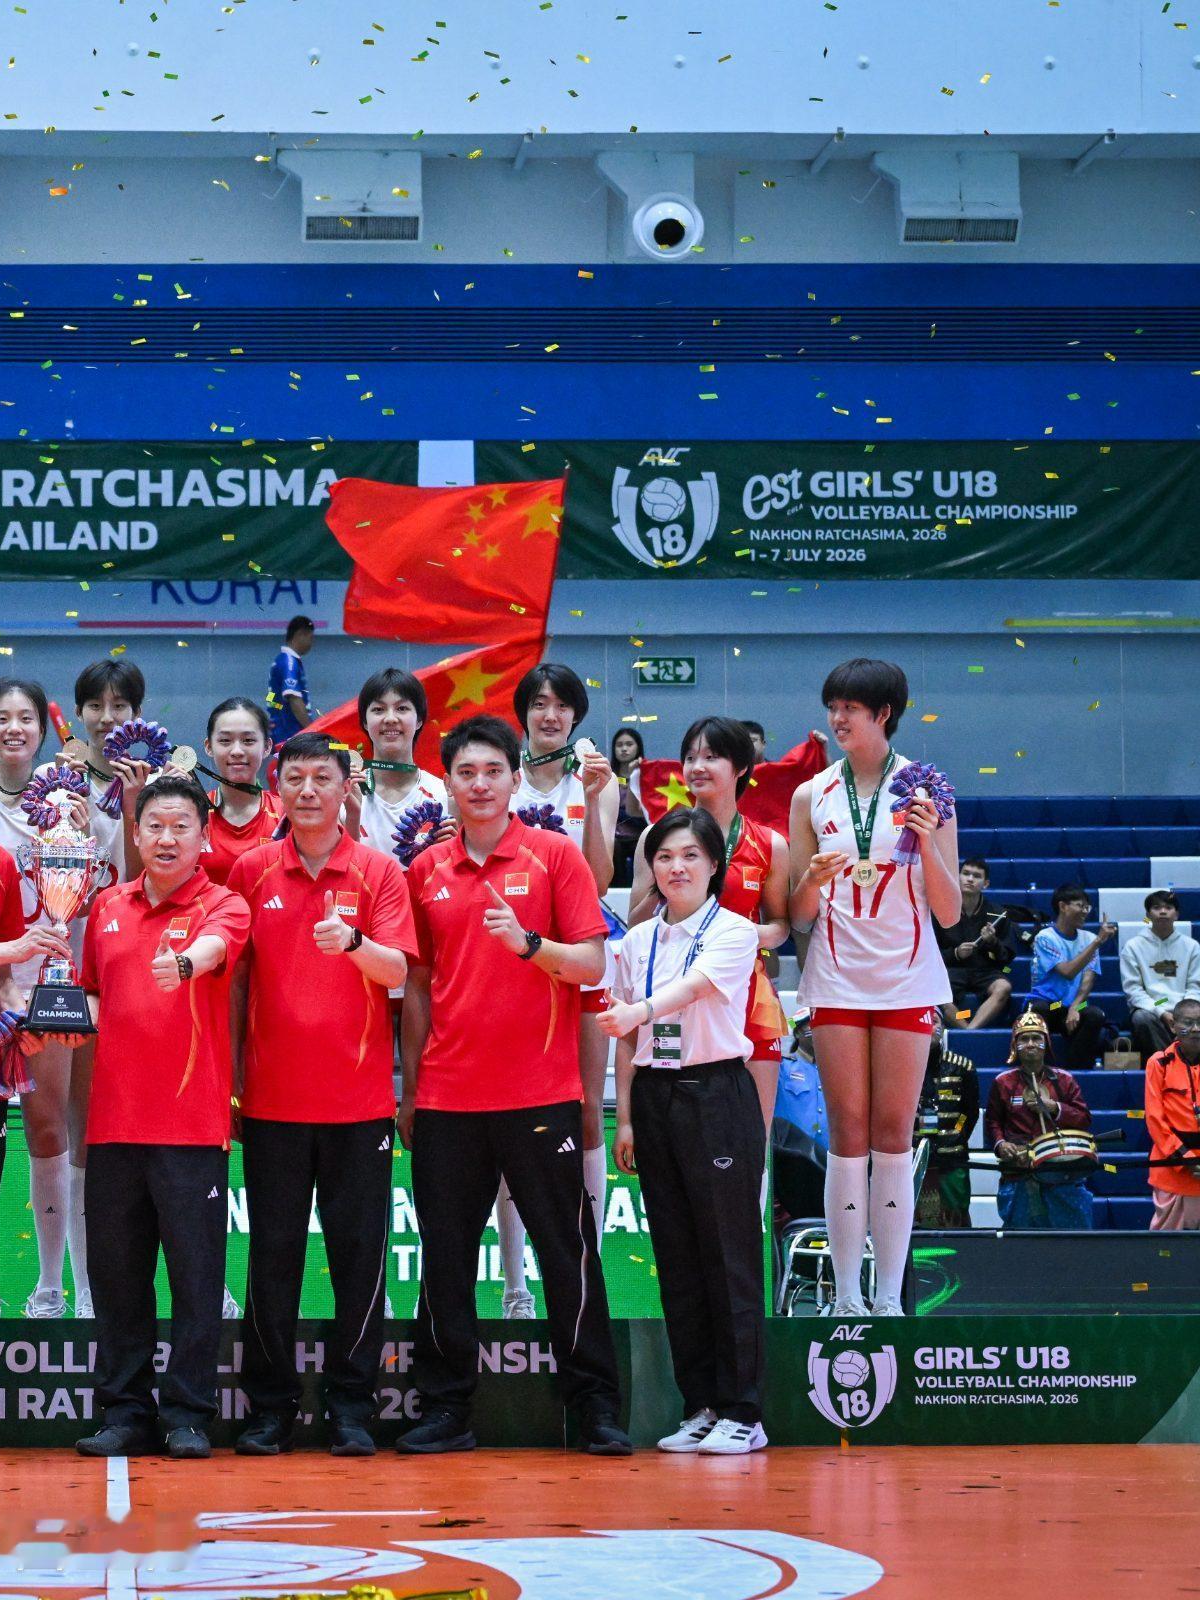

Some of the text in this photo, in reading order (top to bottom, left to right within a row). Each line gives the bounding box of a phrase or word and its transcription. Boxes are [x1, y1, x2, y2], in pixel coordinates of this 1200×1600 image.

[638, 447, 691, 466] AVC
[2, 469, 340, 507] RATCHASIMA
[809, 470, 998, 498] GIRLS' U18
[742, 468, 803, 520] est
[810, 504, 1078, 520] VOLLEYBALL CHAMPIONSHIP
[646, 523, 687, 557] 18
[750, 529, 947, 542] NAKHON RATCHASIMA, 2026
[784, 549, 822, 561] JULY
[826, 549, 866, 561] 2026
[844, 862, 897, 918] 17
[337, 906, 355, 914] CHN
[37, 1010, 83, 1018] CHAMPION
[829, 1325, 873, 1341] AVC
[913, 1346, 1070, 1370] GIRLS' U18
[915, 1375, 1137, 1389] VOLLEYBALL CHAMPIONSHIP
[836, 1389, 871, 1419] 18
[915, 1394, 1079, 1406] NAKHON RATCHASIMA, 2026
